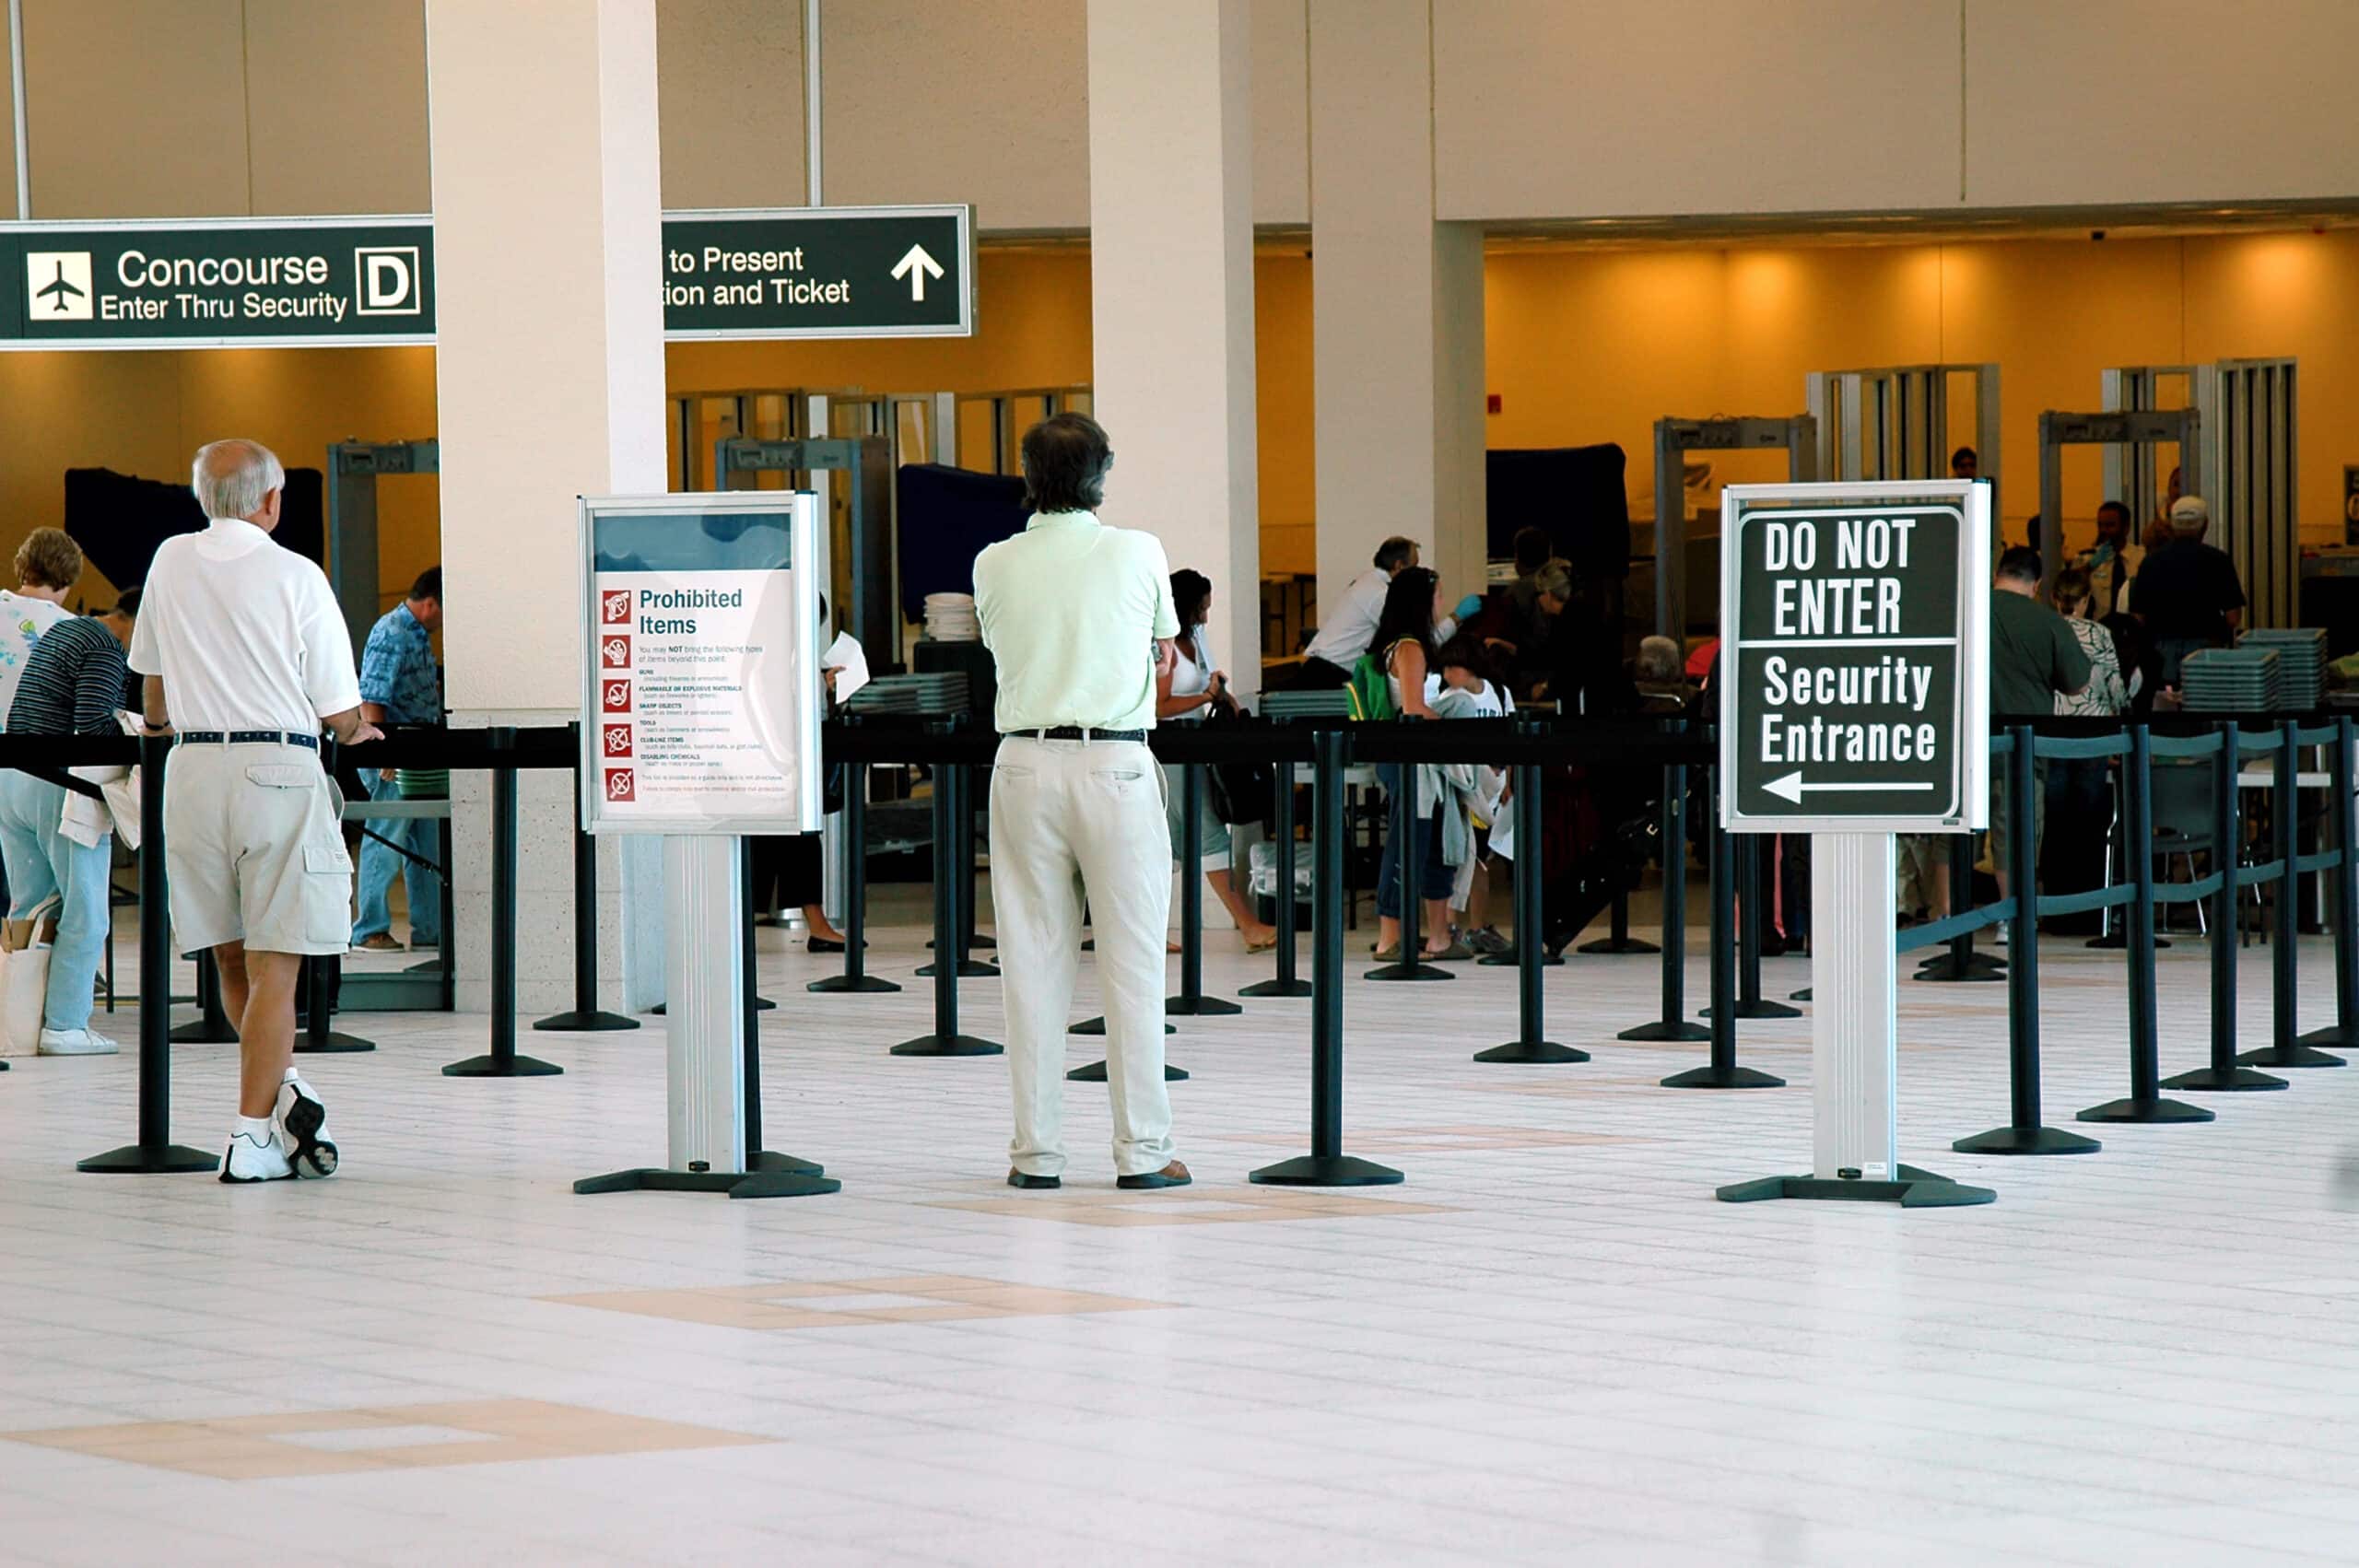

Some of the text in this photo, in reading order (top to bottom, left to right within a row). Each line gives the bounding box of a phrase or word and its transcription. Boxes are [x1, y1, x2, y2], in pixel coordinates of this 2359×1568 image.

[117, 250, 410, 308] Concourse D
[669, 246, 804, 274] to Present
[100, 290, 347, 323] Enter Thru Security
[662, 278, 851, 307] ion and Ticket
[1765, 519, 1917, 572] DO NOT
[640, 589, 743, 609] Prohibited
[1774, 577, 1902, 636] ENTER
[640, 615, 698, 635] Items
[1764, 655, 1932, 711] Security
[1761, 713, 1936, 763] Entrance
